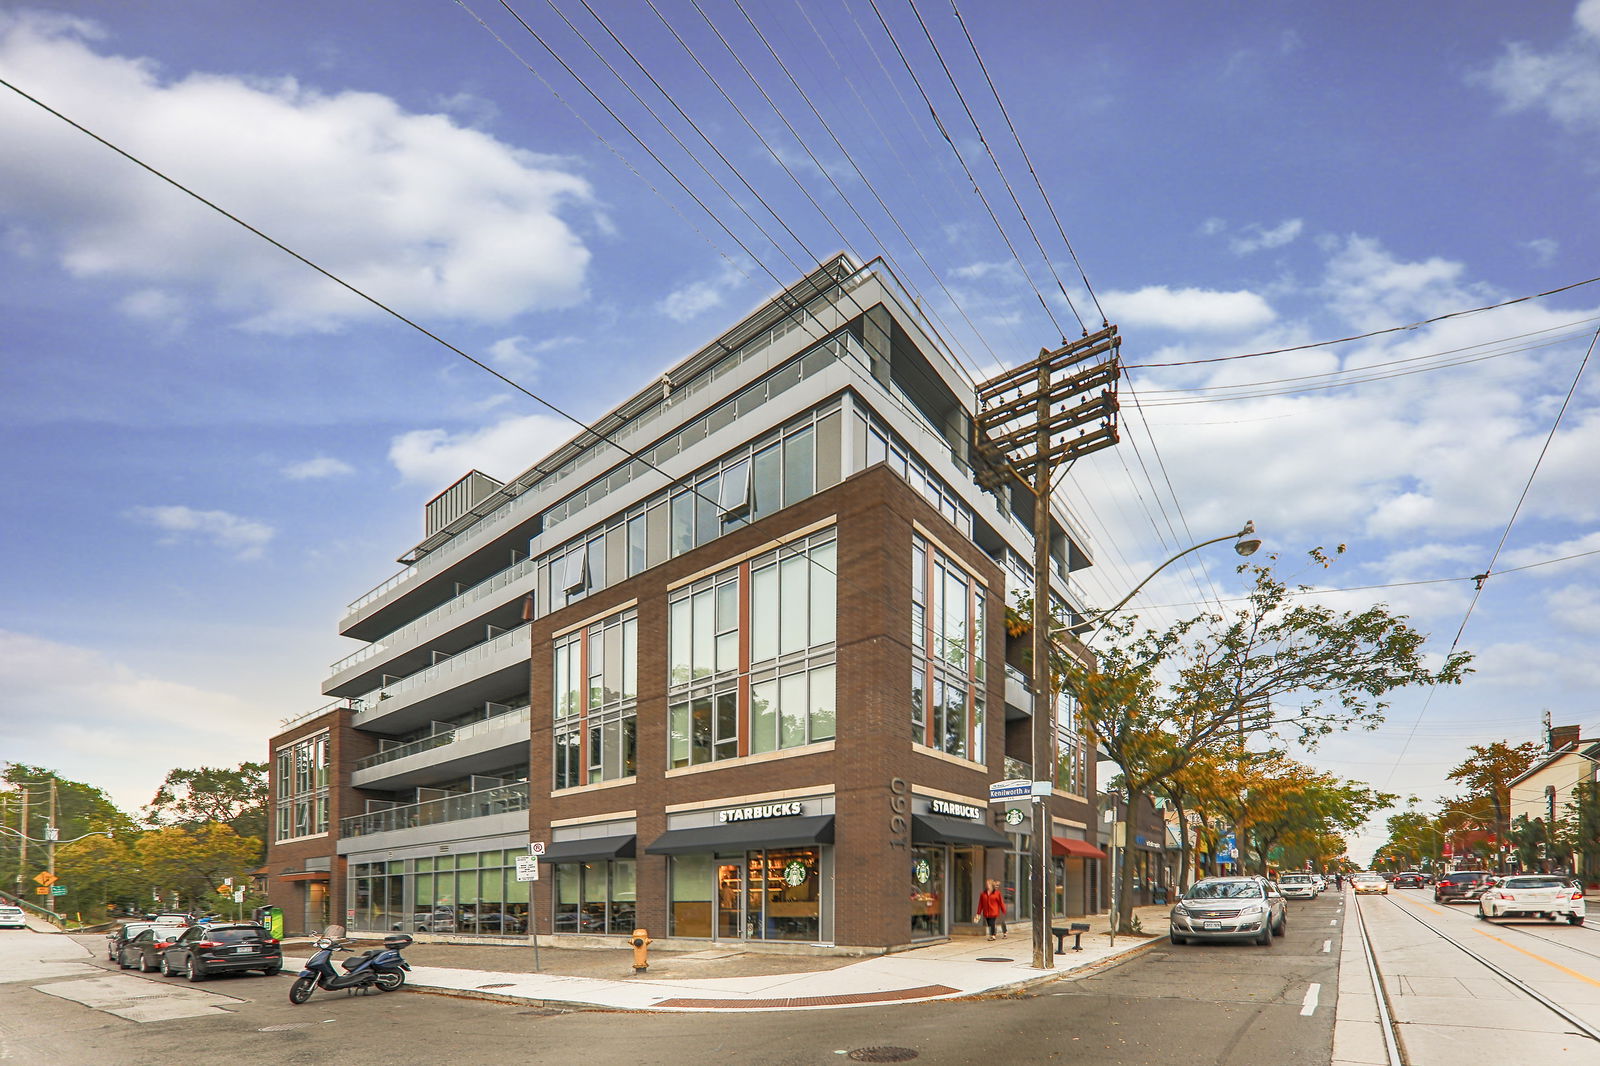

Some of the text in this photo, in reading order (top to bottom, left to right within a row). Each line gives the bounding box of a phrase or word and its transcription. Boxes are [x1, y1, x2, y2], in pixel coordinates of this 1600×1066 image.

[991, 788, 1023, 798] Kenilworth
[719, 802, 801, 823] STARBUCKS
[891, 777, 907, 851] 1960
[933, 800, 979, 818] STARBUCKS
